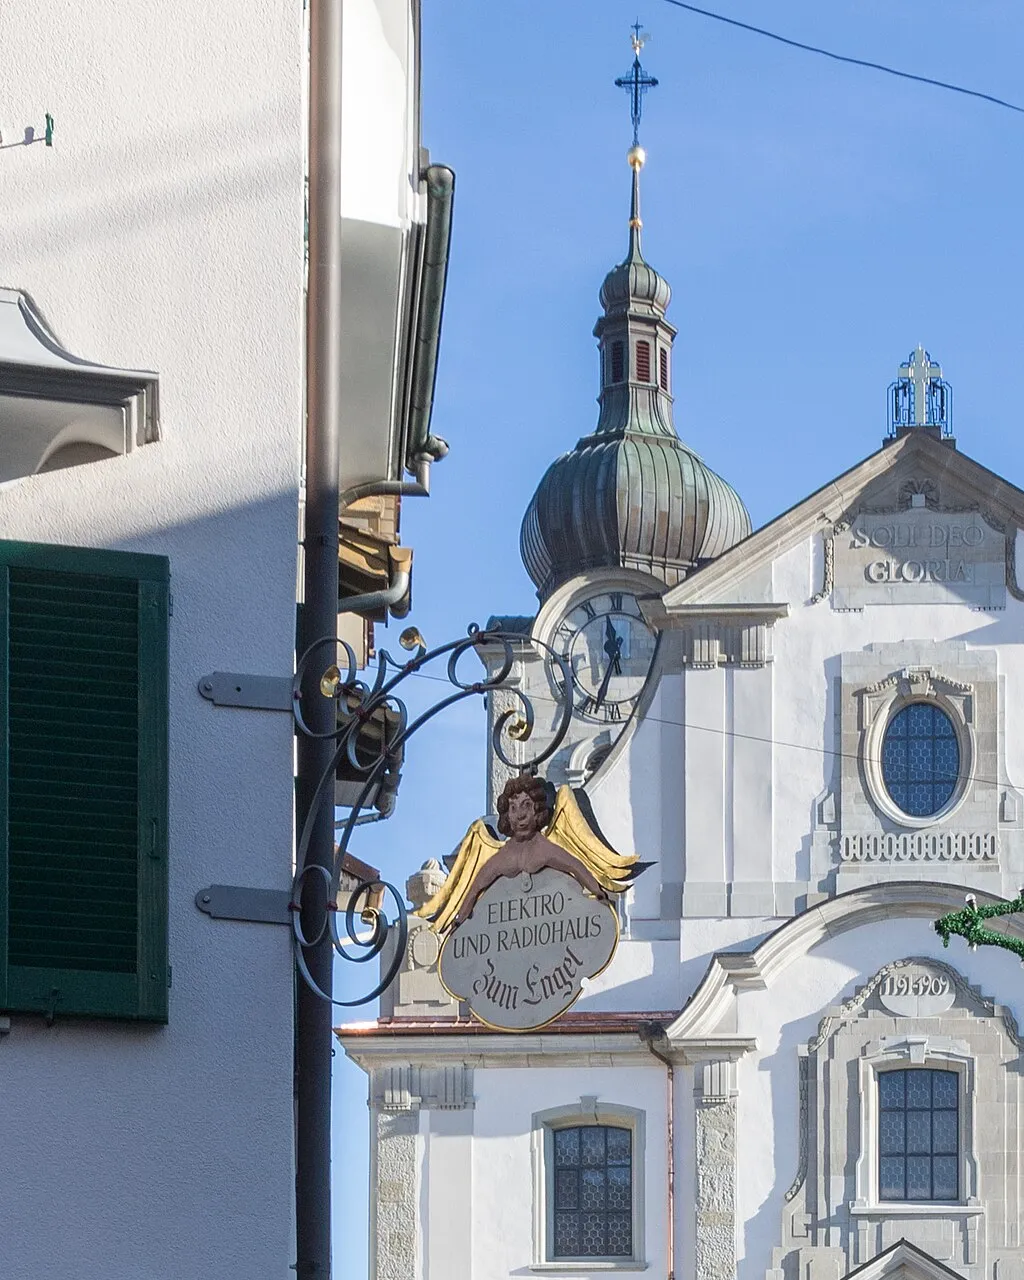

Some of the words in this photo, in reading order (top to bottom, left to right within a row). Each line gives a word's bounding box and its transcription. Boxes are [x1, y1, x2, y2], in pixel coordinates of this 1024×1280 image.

[850, 525, 917, 549] SOLI
[929, 525, 984, 548] DEO
[865, 559, 972, 583] GLORIA
[488, 891, 573, 924] ELEKTRO-
[453, 936, 491, 958] UND
[497, 914, 602, 951] RADIOHAUS
[473, 959, 519, 1010] Zum
[523, 946, 583, 1005] Engel
